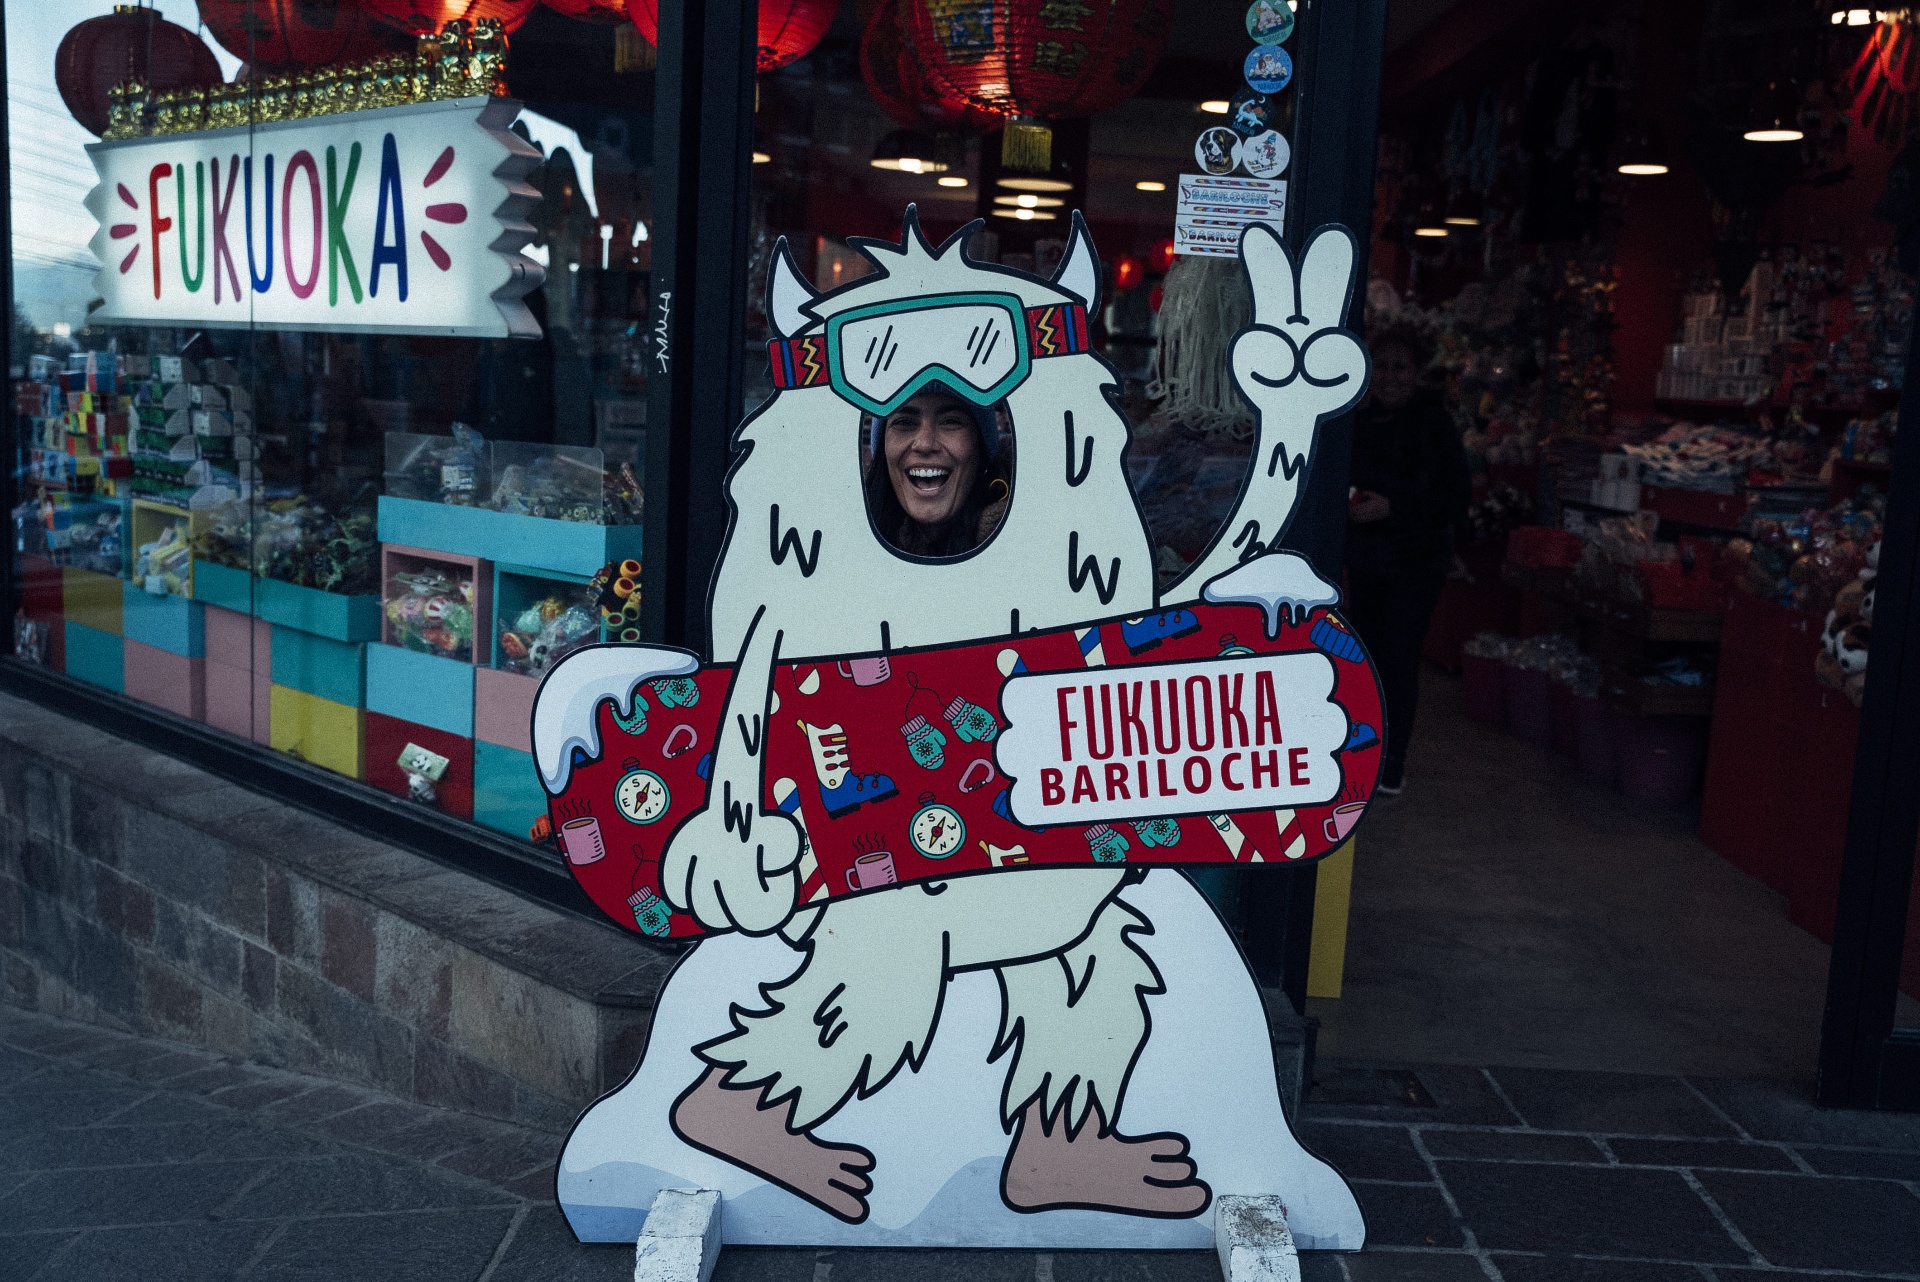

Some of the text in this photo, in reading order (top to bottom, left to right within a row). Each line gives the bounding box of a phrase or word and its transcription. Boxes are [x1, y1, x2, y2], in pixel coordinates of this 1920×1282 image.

[1191, 189, 1269, 205] BARILOCHE
[150, 132, 408, 307] FUKUOKA
[1188, 229, 1239, 243] BARILO
[1056, 670, 1282, 761] FUKUOKA
[1040, 747, 1310, 806] BARILOCHE
[632, 779, 640, 787] S
[652, 788, 661, 796] W
[622, 798, 630, 807] E
[645, 807, 651, 816] N
[927, 813, 935, 822] S
[947, 822, 957, 830] W
[917, 832, 925, 842] E
[940, 841, 947, 851] N
